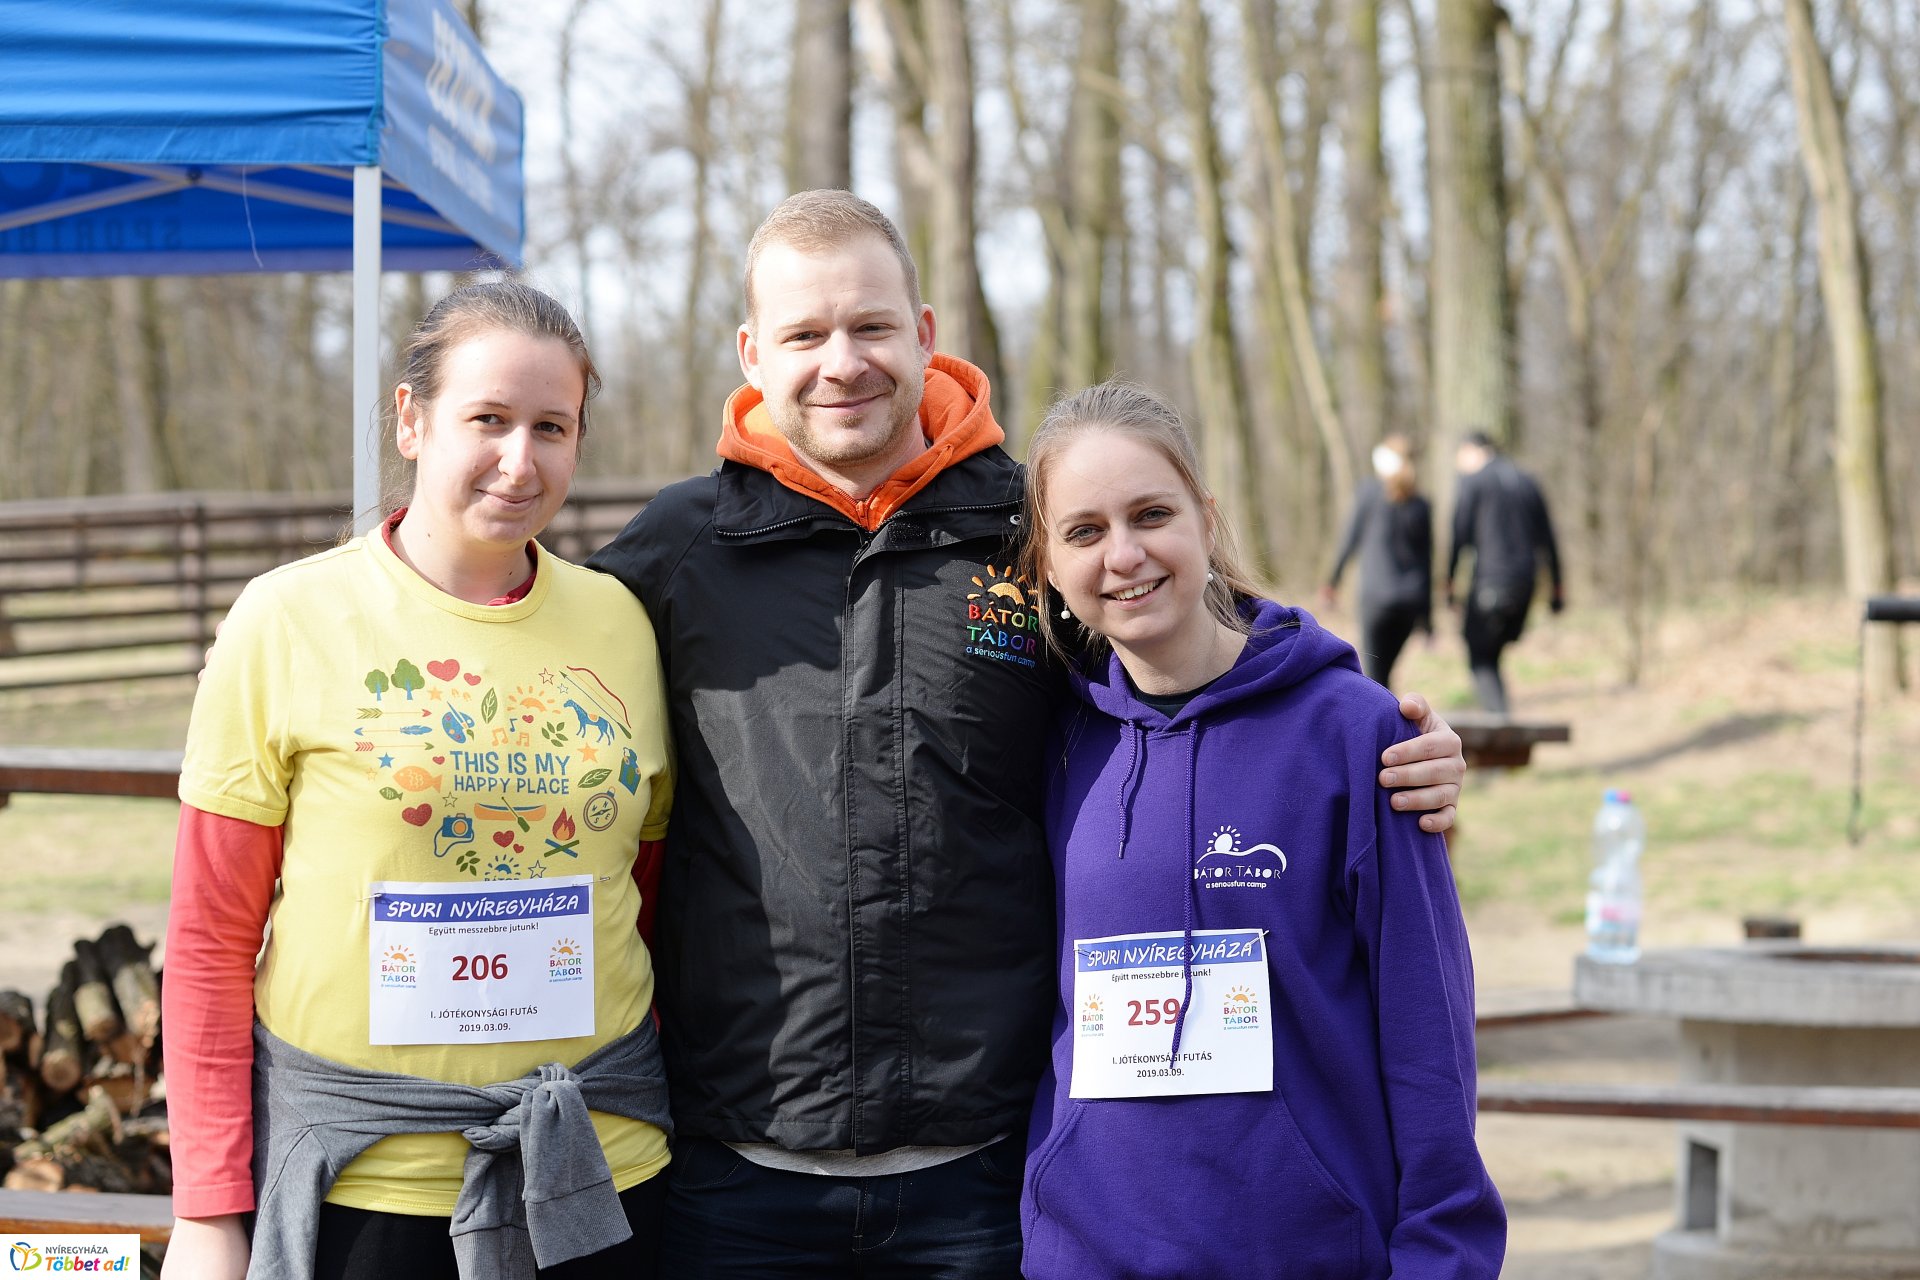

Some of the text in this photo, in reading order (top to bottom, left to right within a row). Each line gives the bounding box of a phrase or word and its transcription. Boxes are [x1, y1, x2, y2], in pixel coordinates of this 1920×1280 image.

[969, 602, 1038, 632] BÁTOR
[967, 624, 1036, 655] TÁBOR
[450, 750, 570, 775] THIS IS MY
[454, 774, 569, 794] HAPPY PLACE
[1194, 865, 1281, 879] BÁTOR TÁBOR
[387, 893, 579, 918] SPURI NYÍREGYHÁZA
[429, 923, 539, 936] Együtt messzebbre jutunk!
[550, 957, 581, 967] BÁTOR
[1087, 949, 1120, 966] SPURI
[382, 963, 416, 973] BÁTOR
[452, 953, 508, 981] 206
[549, 968, 582, 977] TÁBOR
[381, 973, 416, 982] TÁBOR
[1112, 973, 1129, 982] Együtt
[1131, 970, 1179, 980] messzebbre
[430, 1006, 538, 1019] I. JÓTÉKONYSÁGI FUTÁS
[1127, 998, 1180, 1026] 259
[1224, 1005, 1257, 1014] BÁTOR
[1083, 1012, 1103, 1021] BÁTOR
[1223, 1015, 1257, 1024] TÁBOR
[459, 1023, 511, 1032] 2019.03.09.
[1082, 1023, 1103, 1031] TÁBOR
[1113, 1056, 1117, 1065] I.
[1183, 1052, 1212, 1061] FUTÁS
[1137, 1068, 1184, 1077] 2019.03.09.
